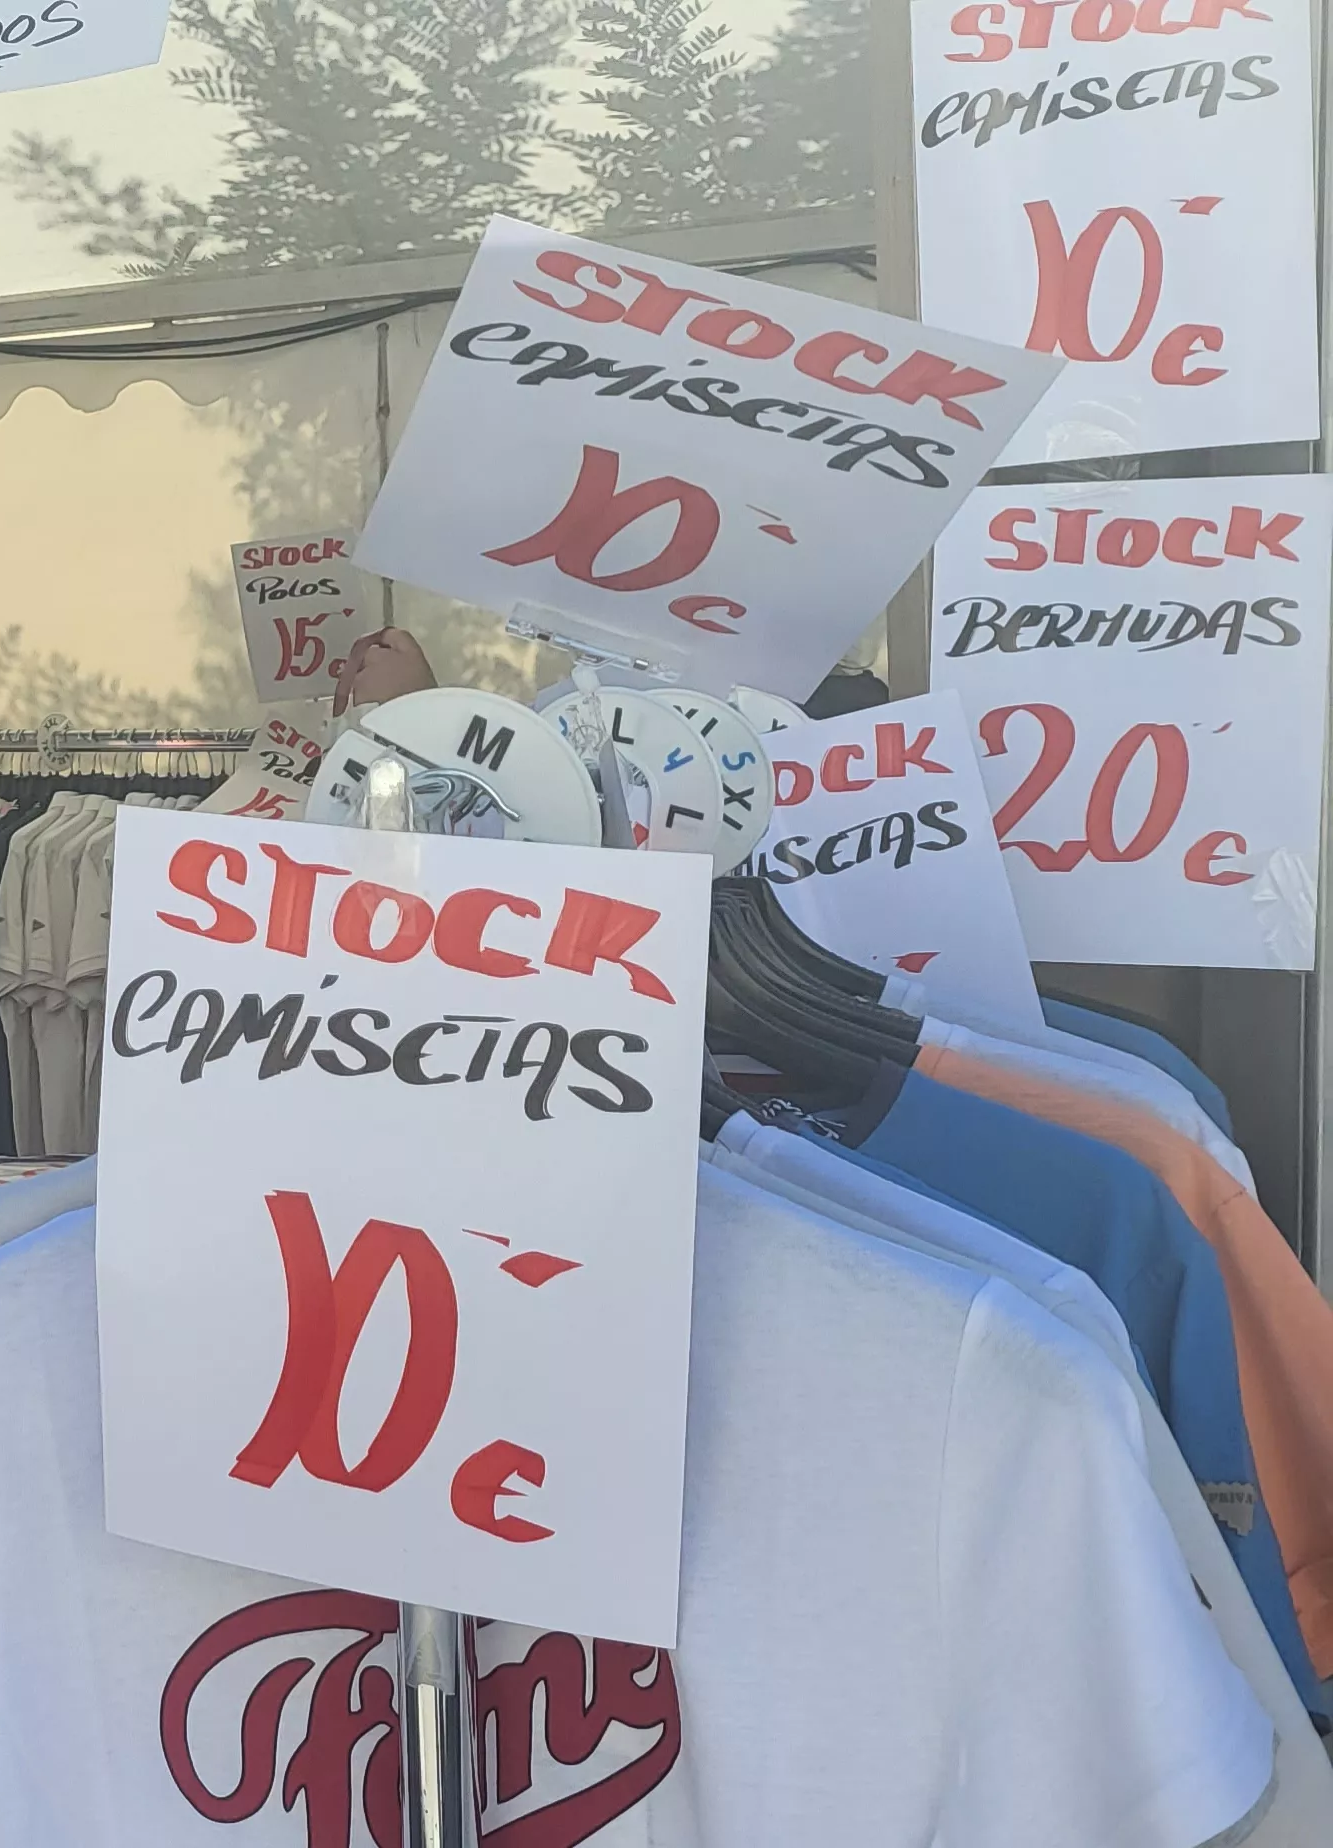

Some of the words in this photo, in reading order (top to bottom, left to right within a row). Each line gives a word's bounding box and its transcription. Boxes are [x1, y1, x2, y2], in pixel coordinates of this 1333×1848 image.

[921, 55, 1280, 148] CAMISETAS
[513, 250, 1008, 431] STOCK
[450, 322, 955, 489] CAMISETAS
[239, 538, 350, 570] STOCK
[984, 506, 1306, 571] STOCK
[942, 597, 1302, 657] BERMUDAS
[457, 714, 516, 773] M
[771, 722, 955, 807] OCK
[156, 839, 677, 1004] STOCK
[111, 970, 654, 1121] CAMISETAS
